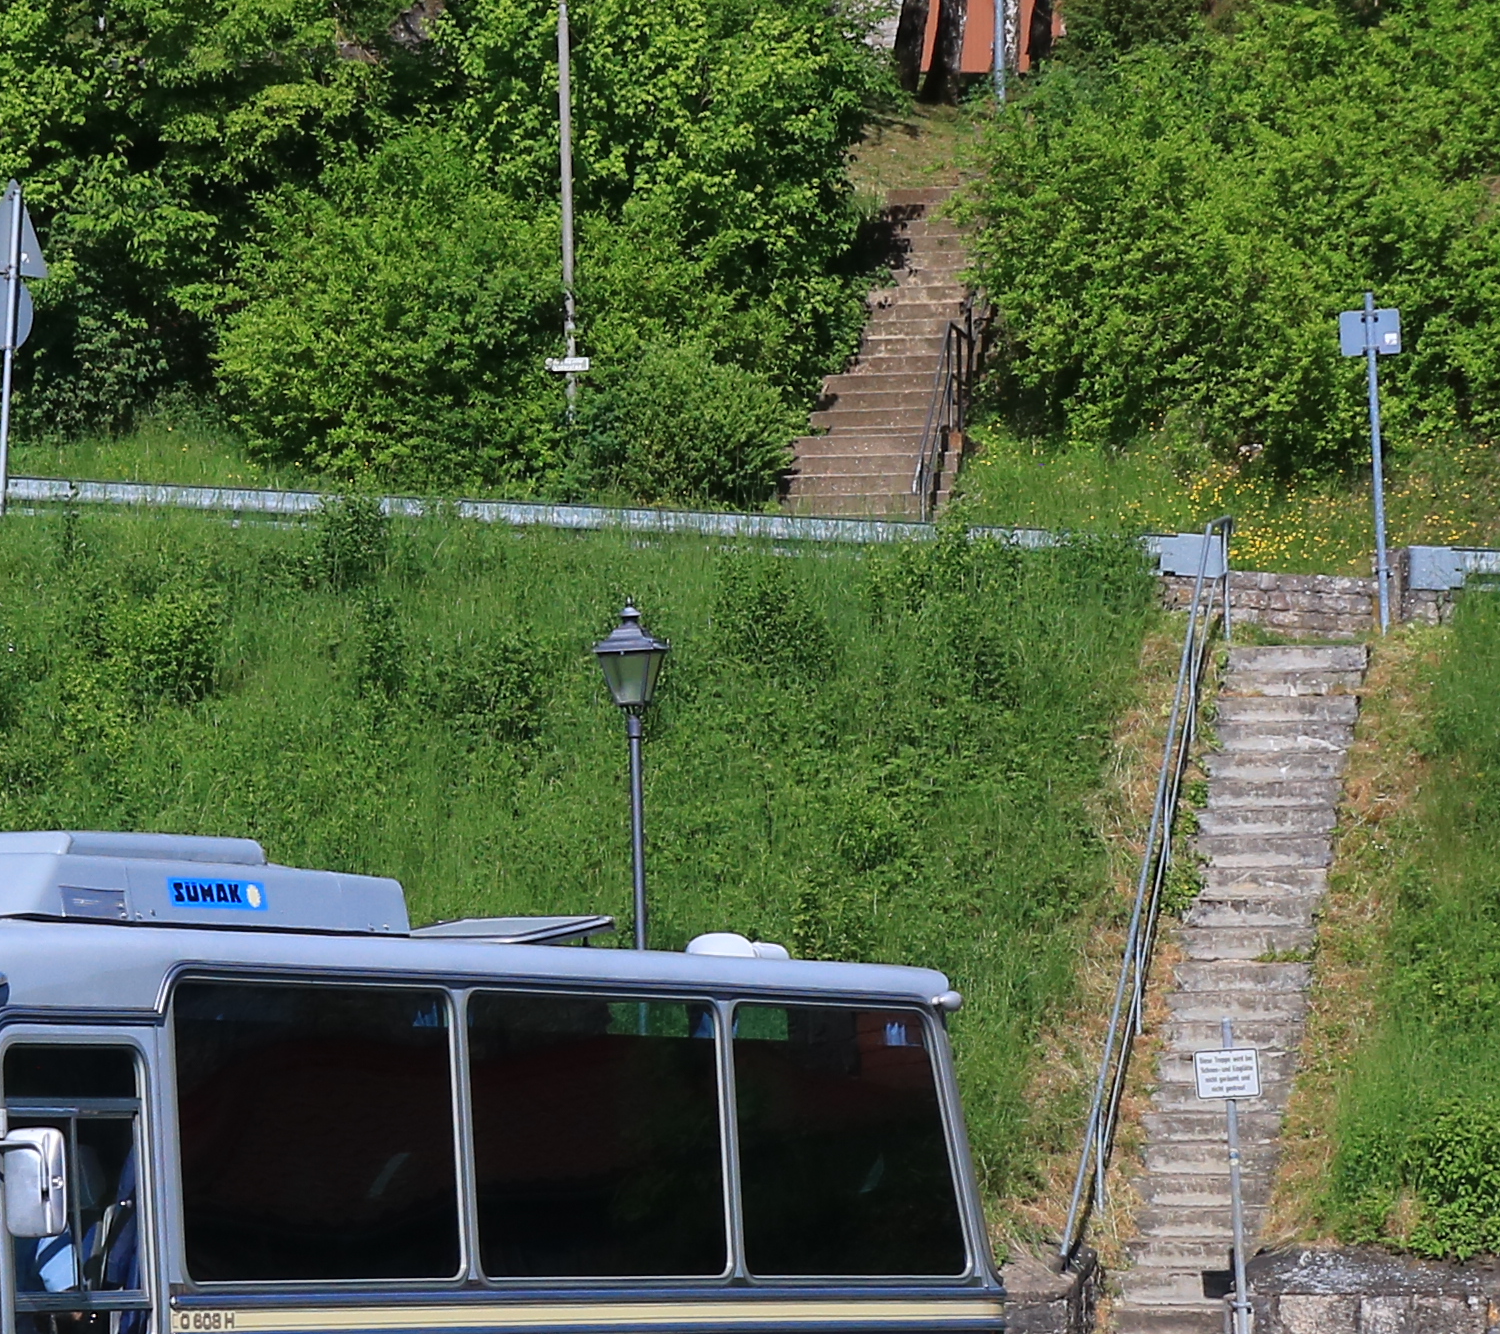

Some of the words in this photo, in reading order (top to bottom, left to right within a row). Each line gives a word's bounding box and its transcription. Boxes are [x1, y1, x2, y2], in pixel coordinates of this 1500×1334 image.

[173, 881, 242, 903] SÜMAK
[193, 1312, 221, 1330] 608
[224, 1312, 235, 1329] H
